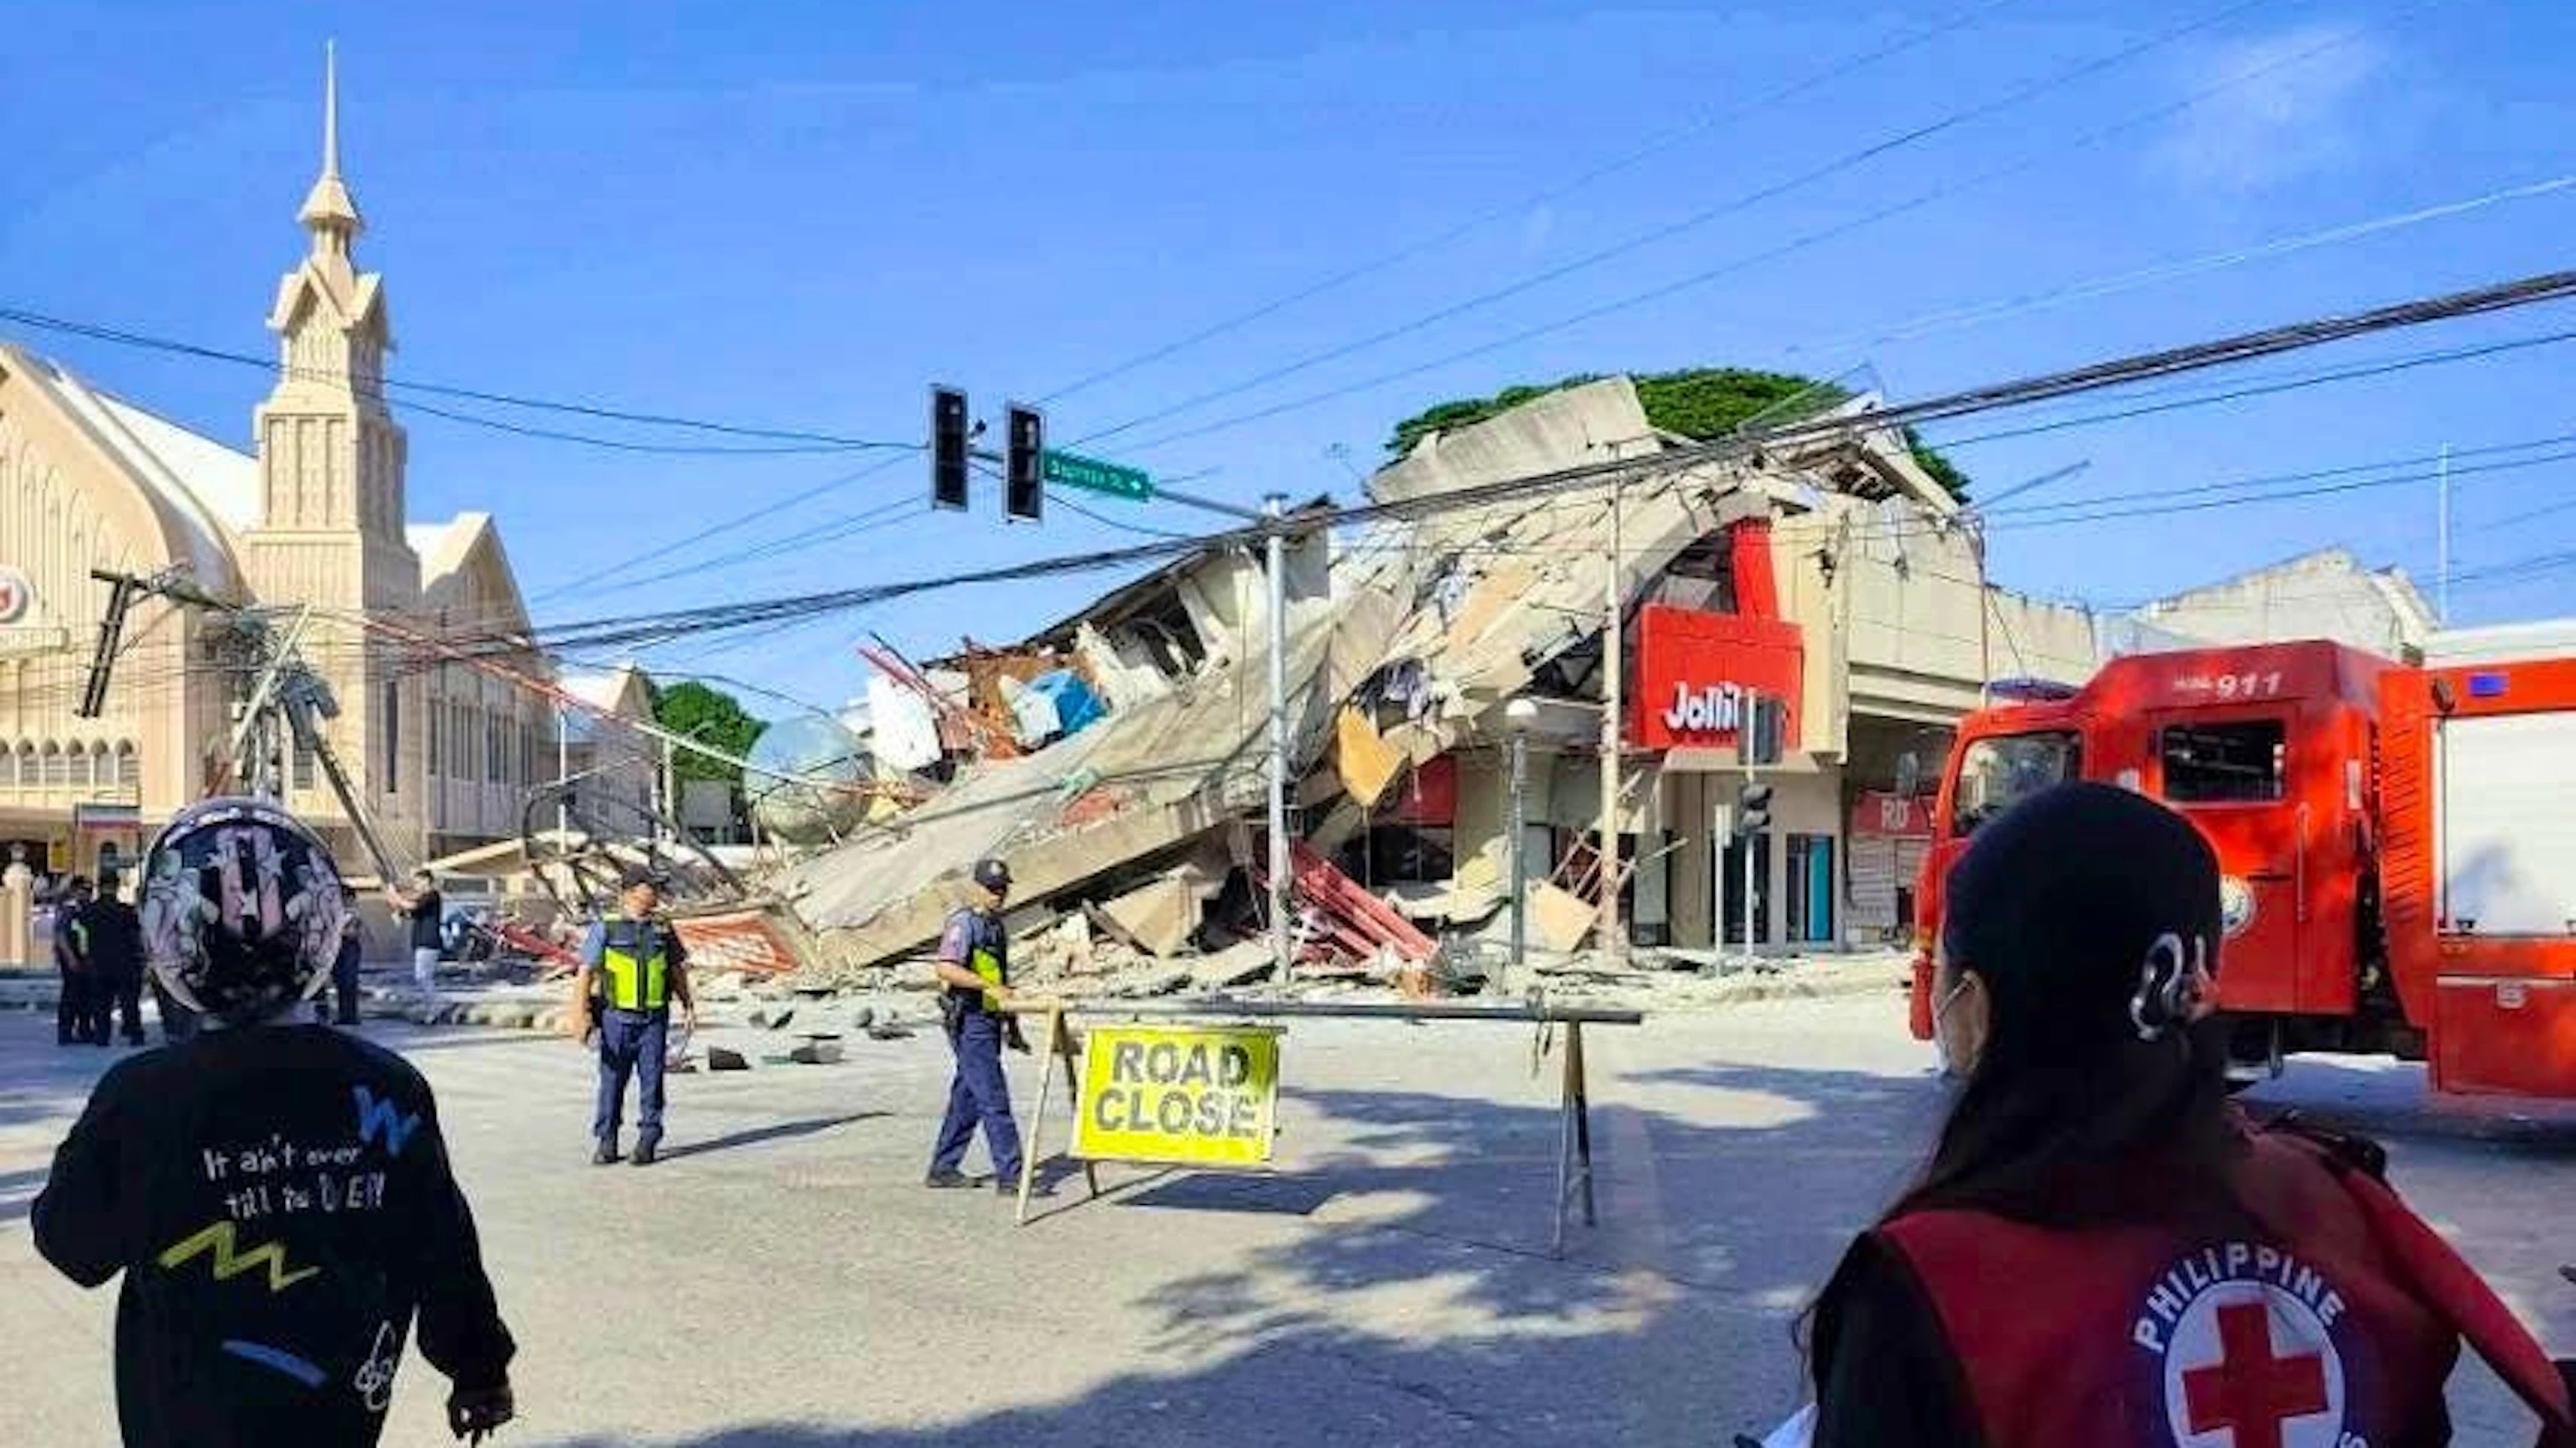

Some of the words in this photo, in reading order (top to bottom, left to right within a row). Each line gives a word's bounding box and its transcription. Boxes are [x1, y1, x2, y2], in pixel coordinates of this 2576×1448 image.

[1662, 680, 1743, 730] Jolli
[2218, 672, 2282, 699] 911
[1113, 1042, 1250, 1088] ROAD
[1095, 1088, 1260, 1137] CLOSE
[2133, 1243, 2345, 1353] PHILIPPINE
